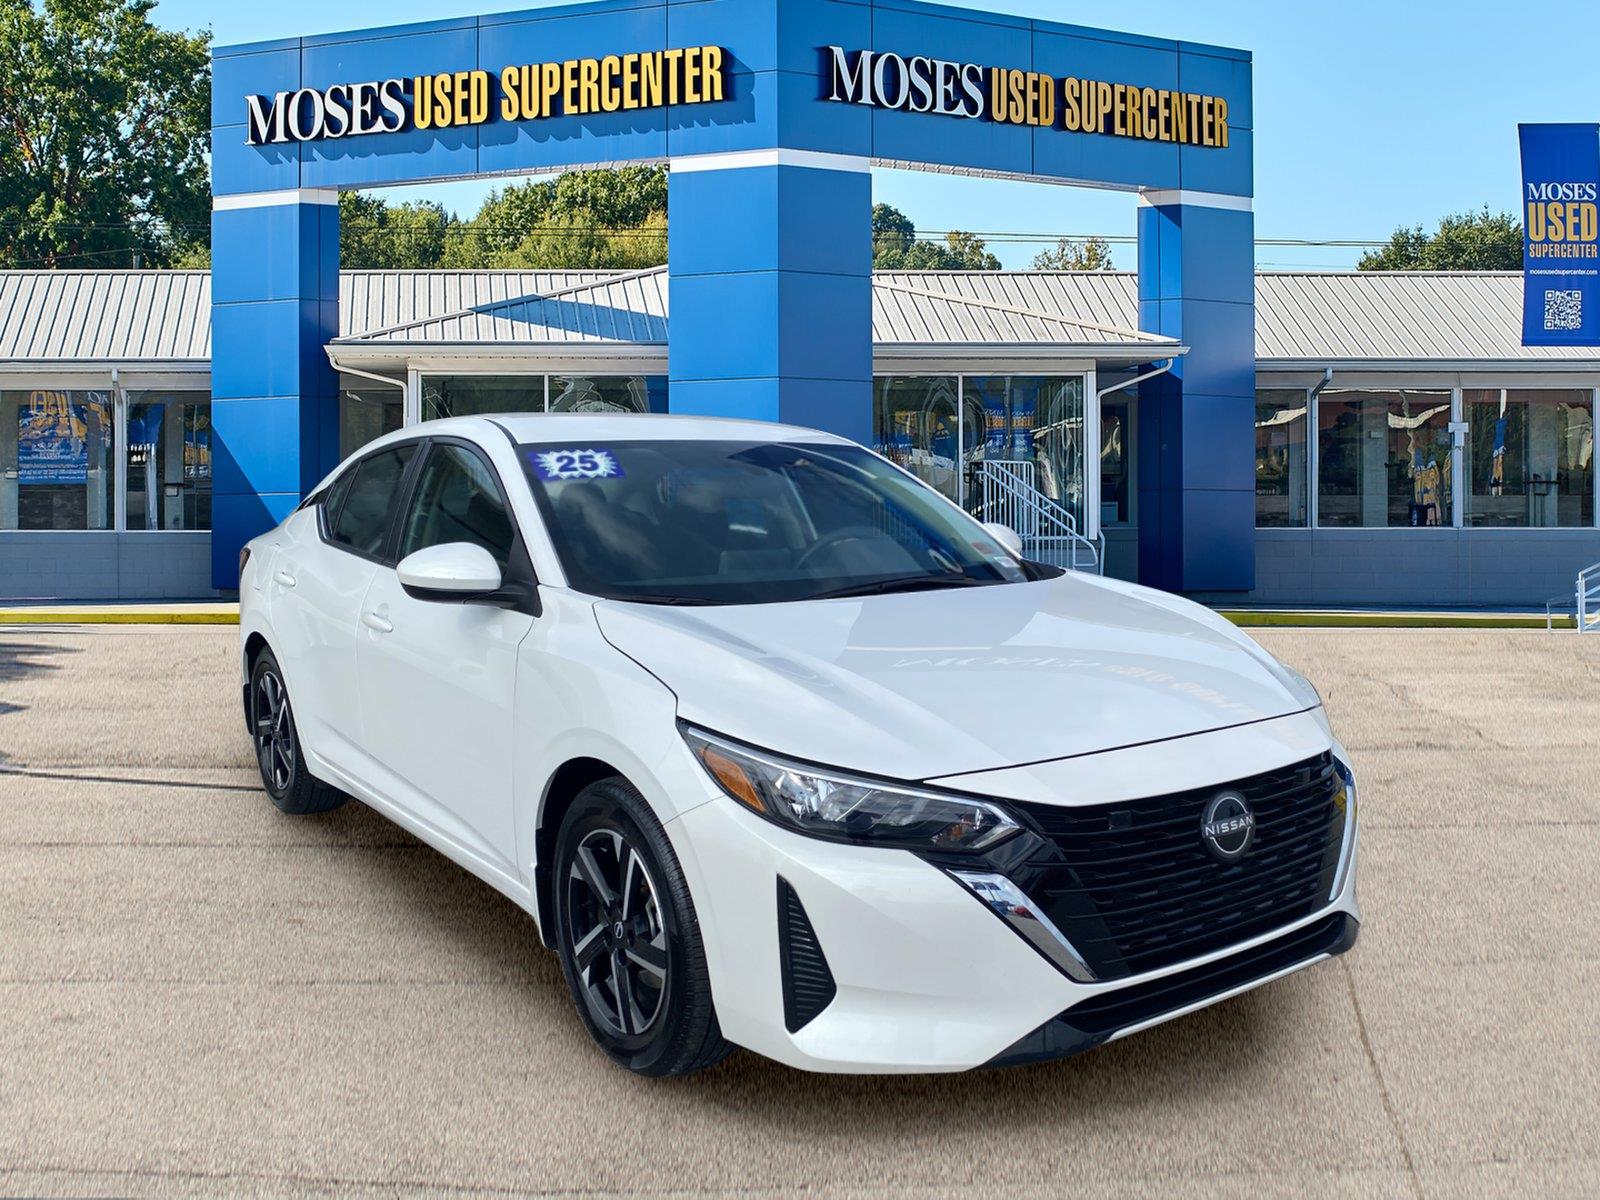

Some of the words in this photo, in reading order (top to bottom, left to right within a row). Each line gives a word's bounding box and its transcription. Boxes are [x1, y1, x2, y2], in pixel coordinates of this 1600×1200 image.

[243, 78, 405, 145] MOSES
[413, 70, 489, 130] USED
[500, 45, 724, 122] SUPERCENTER
[828, 45, 985, 119] MOSES
[991, 67, 1056, 127] USED
[1064, 77, 1230, 148] SUPERCENTER
[1527, 182, 1597, 200] MOSES
[1527, 202, 1598, 242] USED
[1529, 243, 1598, 259] SUPERCENTER
[556, 455, 600, 472] 25
[1205, 815, 1253, 836] NISSAN
